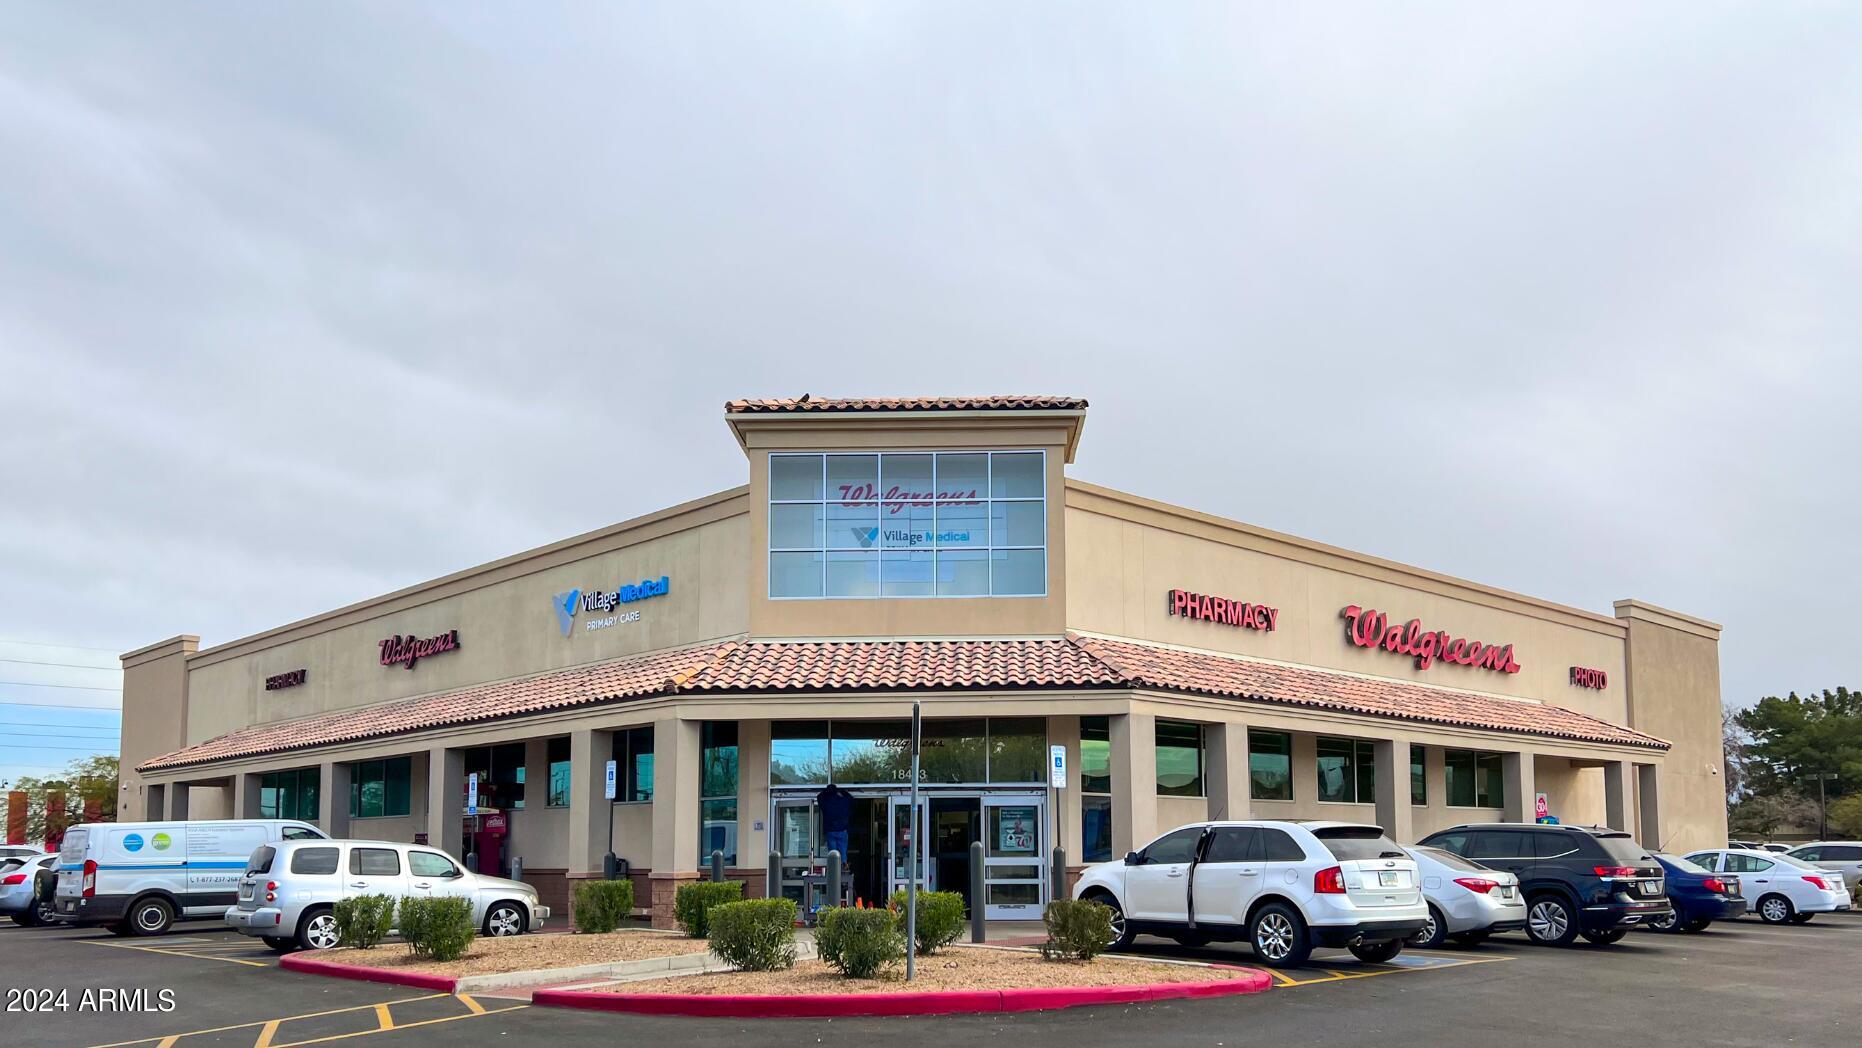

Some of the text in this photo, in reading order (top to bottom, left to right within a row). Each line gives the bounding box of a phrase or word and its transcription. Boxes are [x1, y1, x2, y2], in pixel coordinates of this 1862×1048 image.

[839, 483, 980, 514] Walgreens
[884, 531, 970, 545] Village Medical
[581, 576, 669, 612] Village Medical
[586, 611, 640, 631] PRIMARY CARE
[1169, 589, 1278, 631] PHARMACY
[378, 630, 460, 669] Walgreens
[1341, 605, 1520, 673] Walgreens
[1570, 666, 1607, 690] PHOTO
[892, 769, 927, 780] 1843
